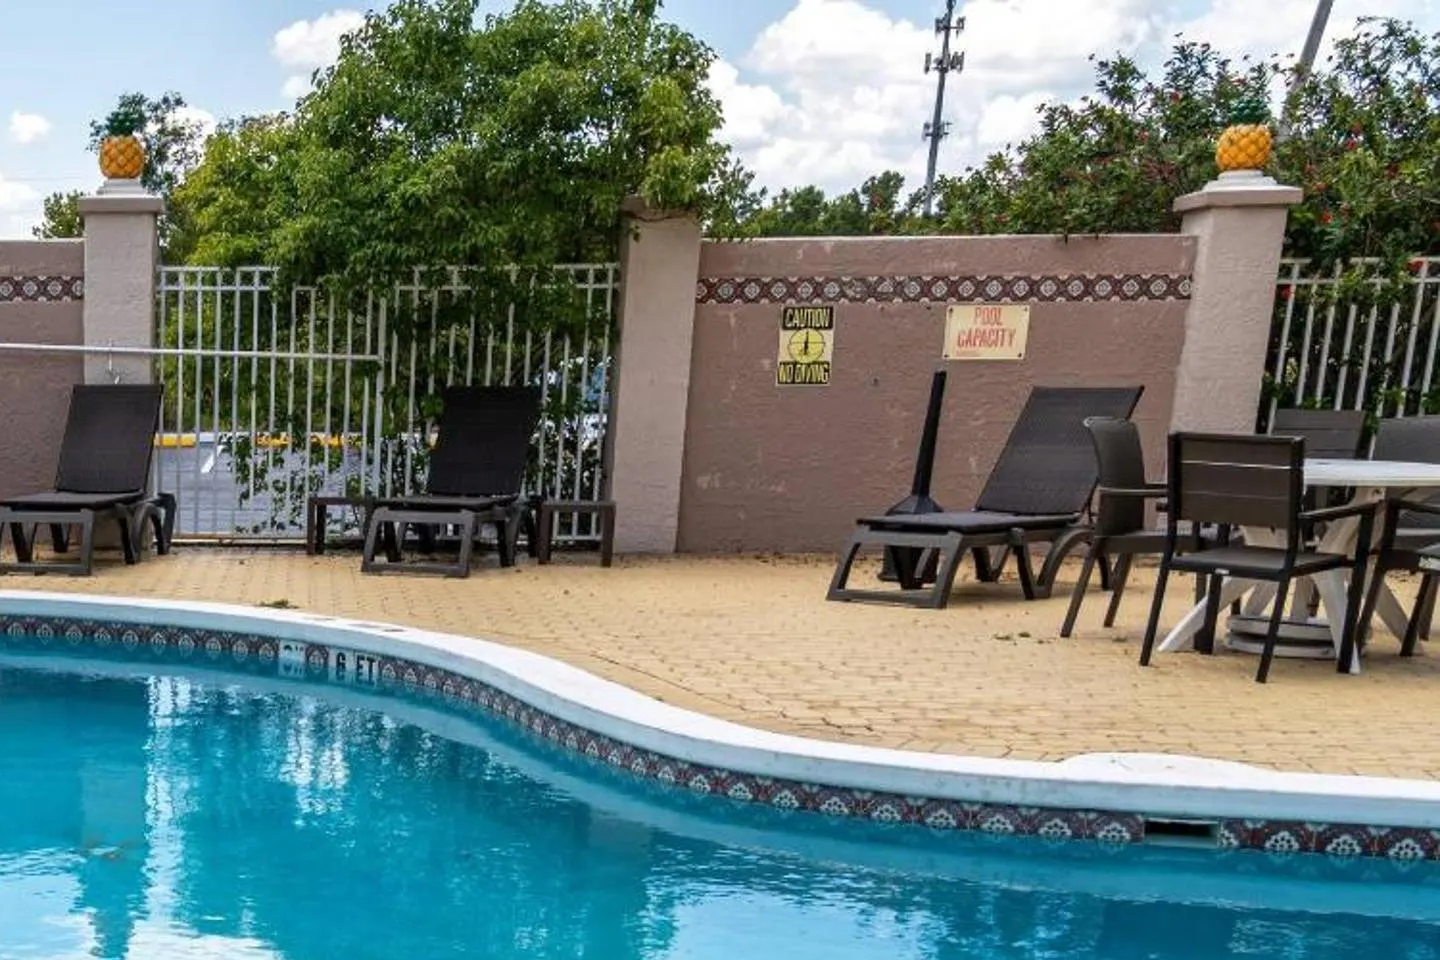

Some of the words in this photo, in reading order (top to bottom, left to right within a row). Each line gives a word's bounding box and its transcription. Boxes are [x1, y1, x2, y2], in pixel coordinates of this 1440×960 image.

[785, 308, 830, 327] CAUTION
[974, 307, 1002, 325] POOL
[957, 327, 1016, 348] CAPACITY
[779, 364, 794, 383] NO
[795, 364, 829, 383] DIVING
